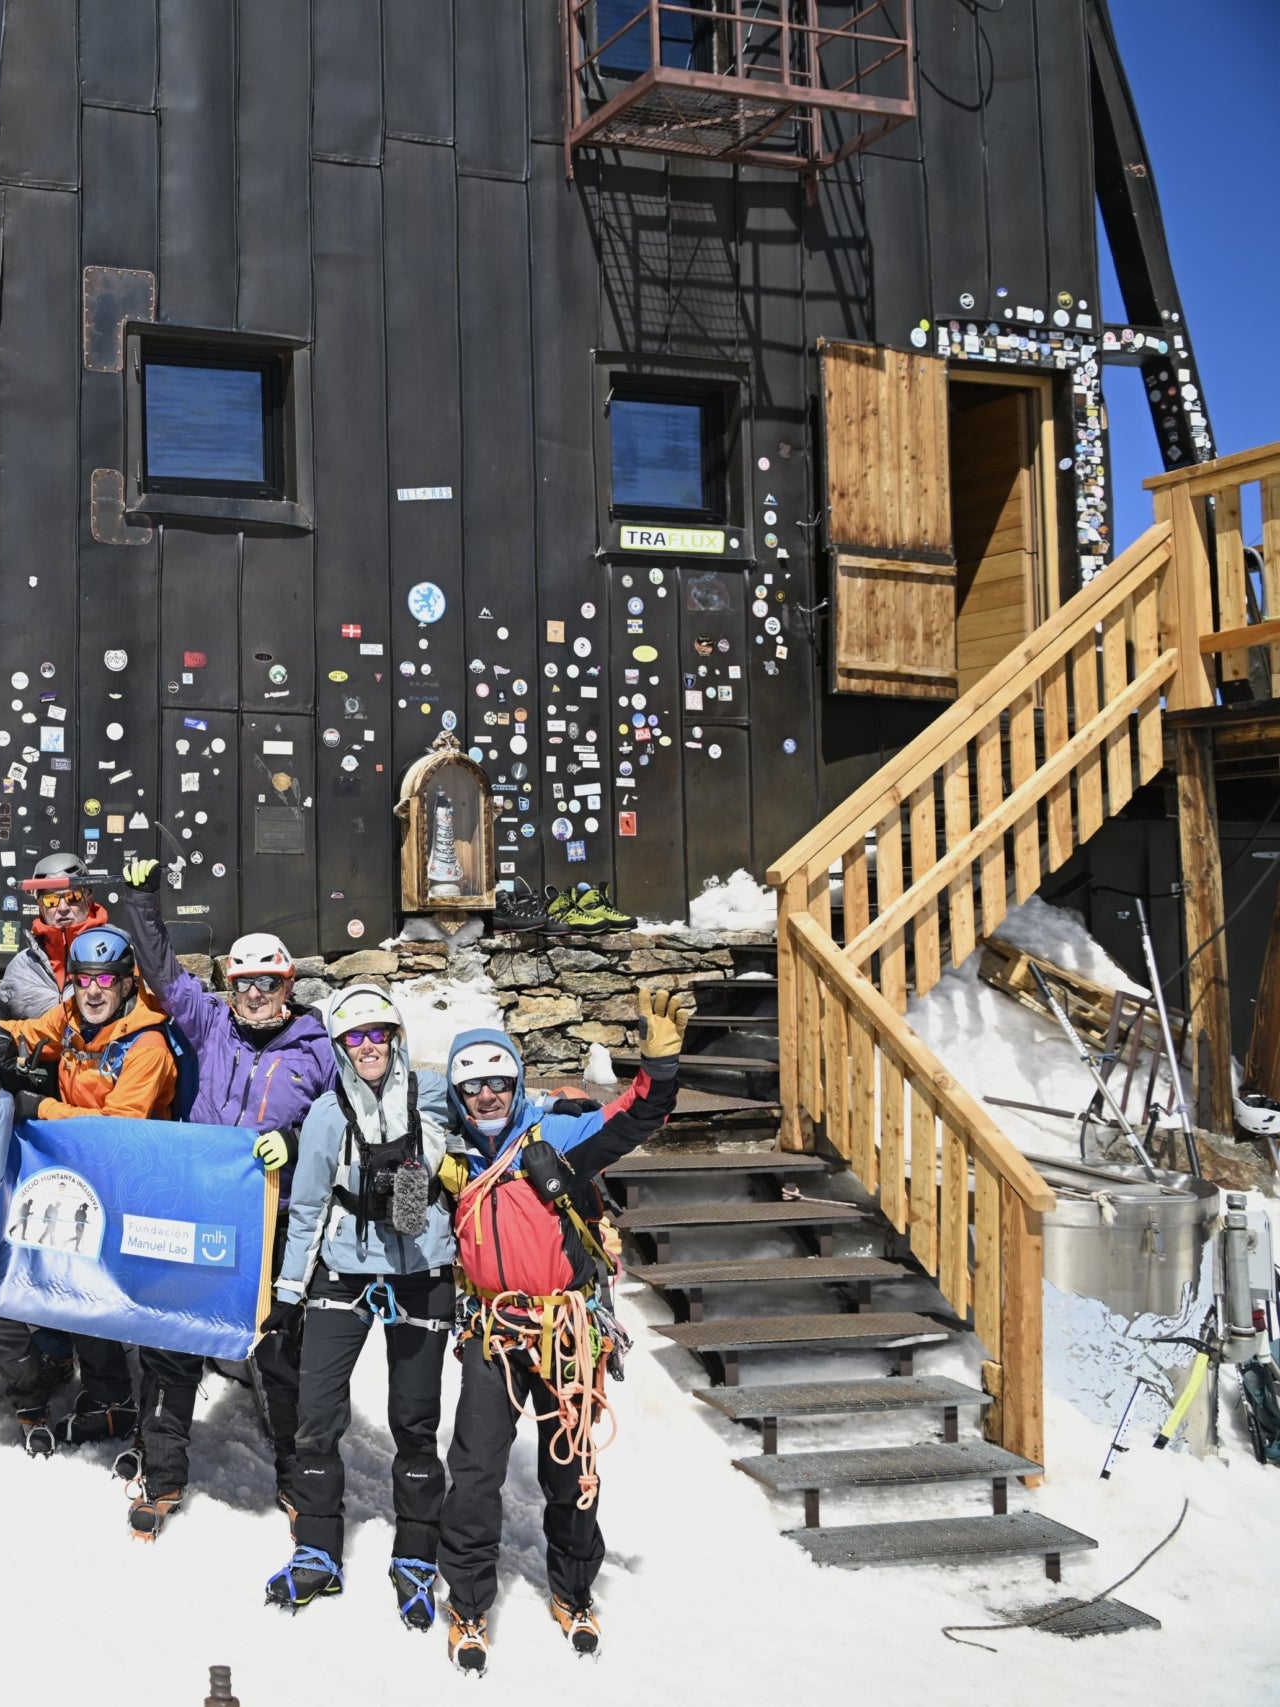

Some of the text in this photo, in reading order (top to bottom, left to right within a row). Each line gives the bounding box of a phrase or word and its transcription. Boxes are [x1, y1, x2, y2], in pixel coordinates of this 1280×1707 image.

[626, 531, 718, 549] TRAFLUX
[76, 1180, 99, 1211] INCLUSIVA
[127, 1236, 188, 1255] Manuel Lao
[202, 1230, 227, 1245] mlh
